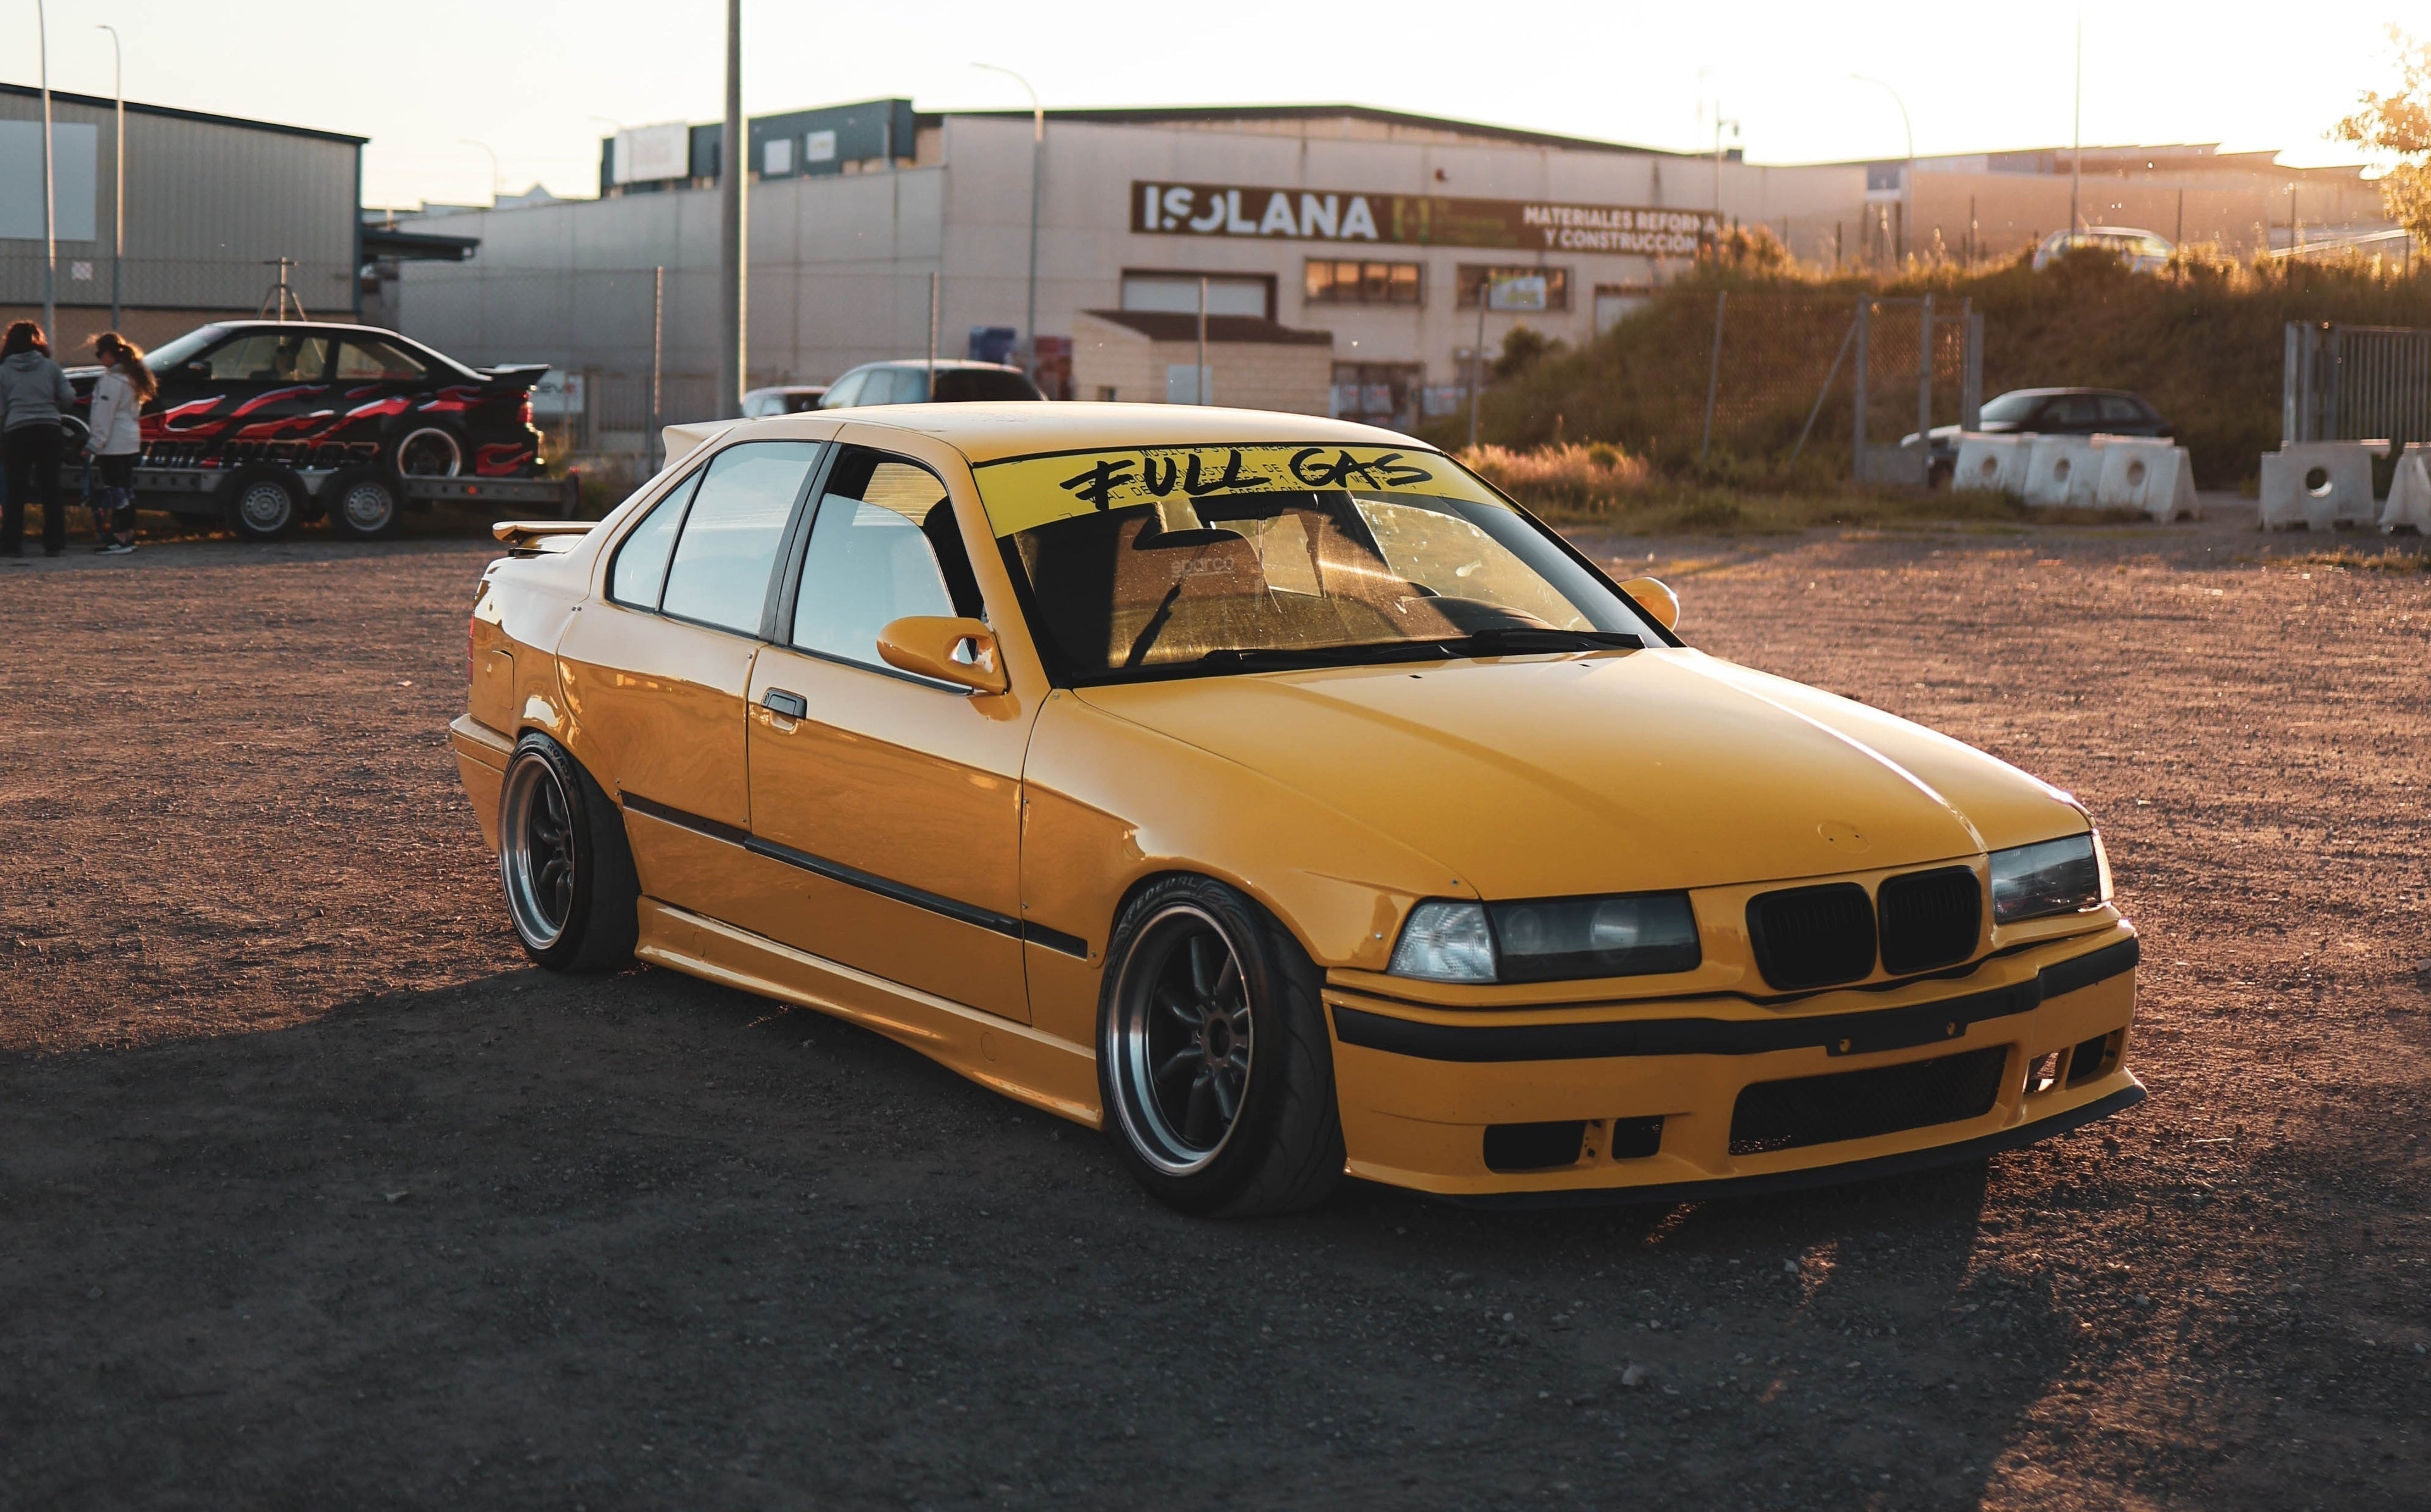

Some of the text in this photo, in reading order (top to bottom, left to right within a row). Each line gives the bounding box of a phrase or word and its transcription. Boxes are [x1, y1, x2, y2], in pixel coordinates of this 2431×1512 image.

[1523, 206, 1633, 230] MATERIALES
[1544, 230, 1556, 246] Y
[1059, 448, 1433, 511] FULL GAS
